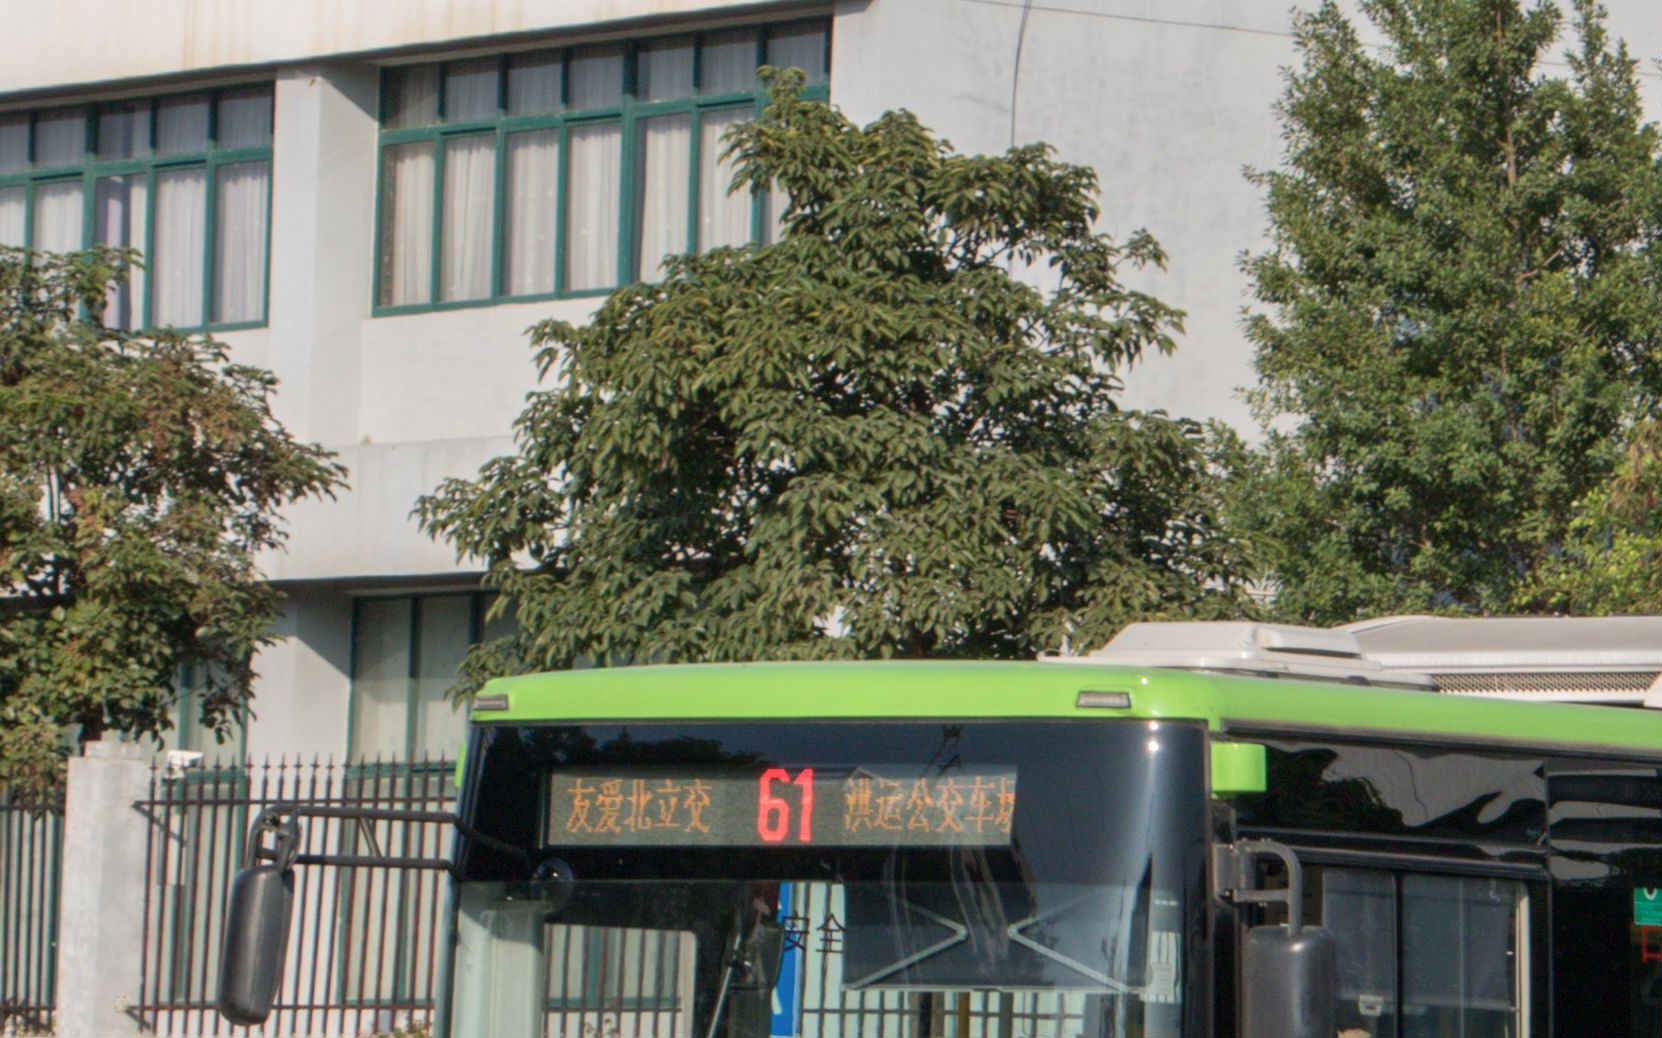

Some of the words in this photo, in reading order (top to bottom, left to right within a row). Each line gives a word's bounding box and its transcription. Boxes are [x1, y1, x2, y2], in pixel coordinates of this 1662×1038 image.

[564, 778, 713, 833] 友爱北立交
[758, 768, 814, 843] 61
